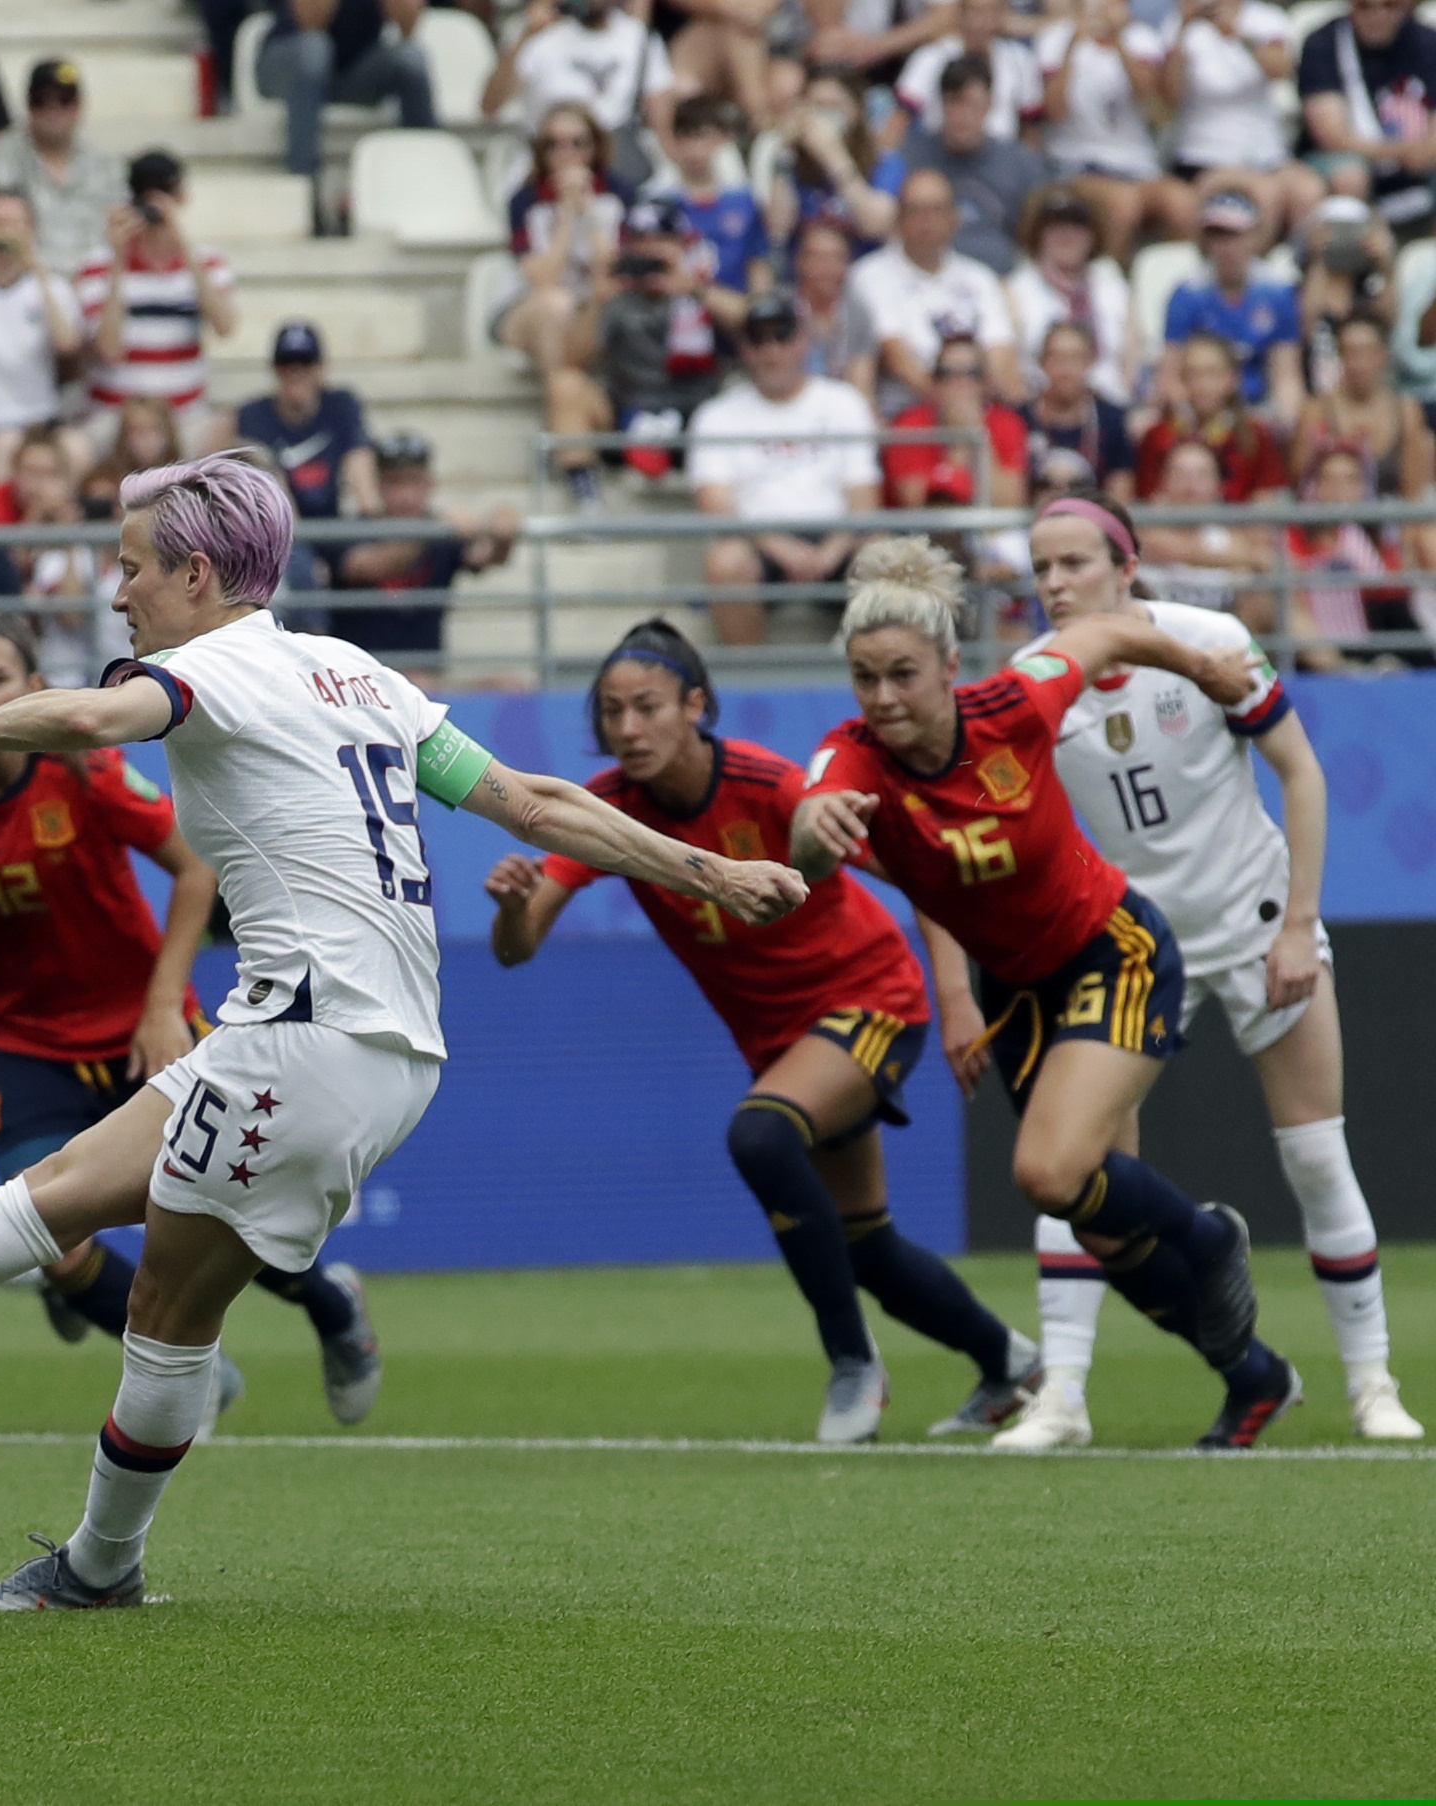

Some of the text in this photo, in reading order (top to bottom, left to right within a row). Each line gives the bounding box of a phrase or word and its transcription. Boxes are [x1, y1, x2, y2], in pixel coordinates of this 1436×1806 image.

[337, 743, 432, 907] 15
[1110, 763, 1169, 833] 16
[1056, 971, 1107, 1027] 6
[169, 1078, 228, 1174] 15
